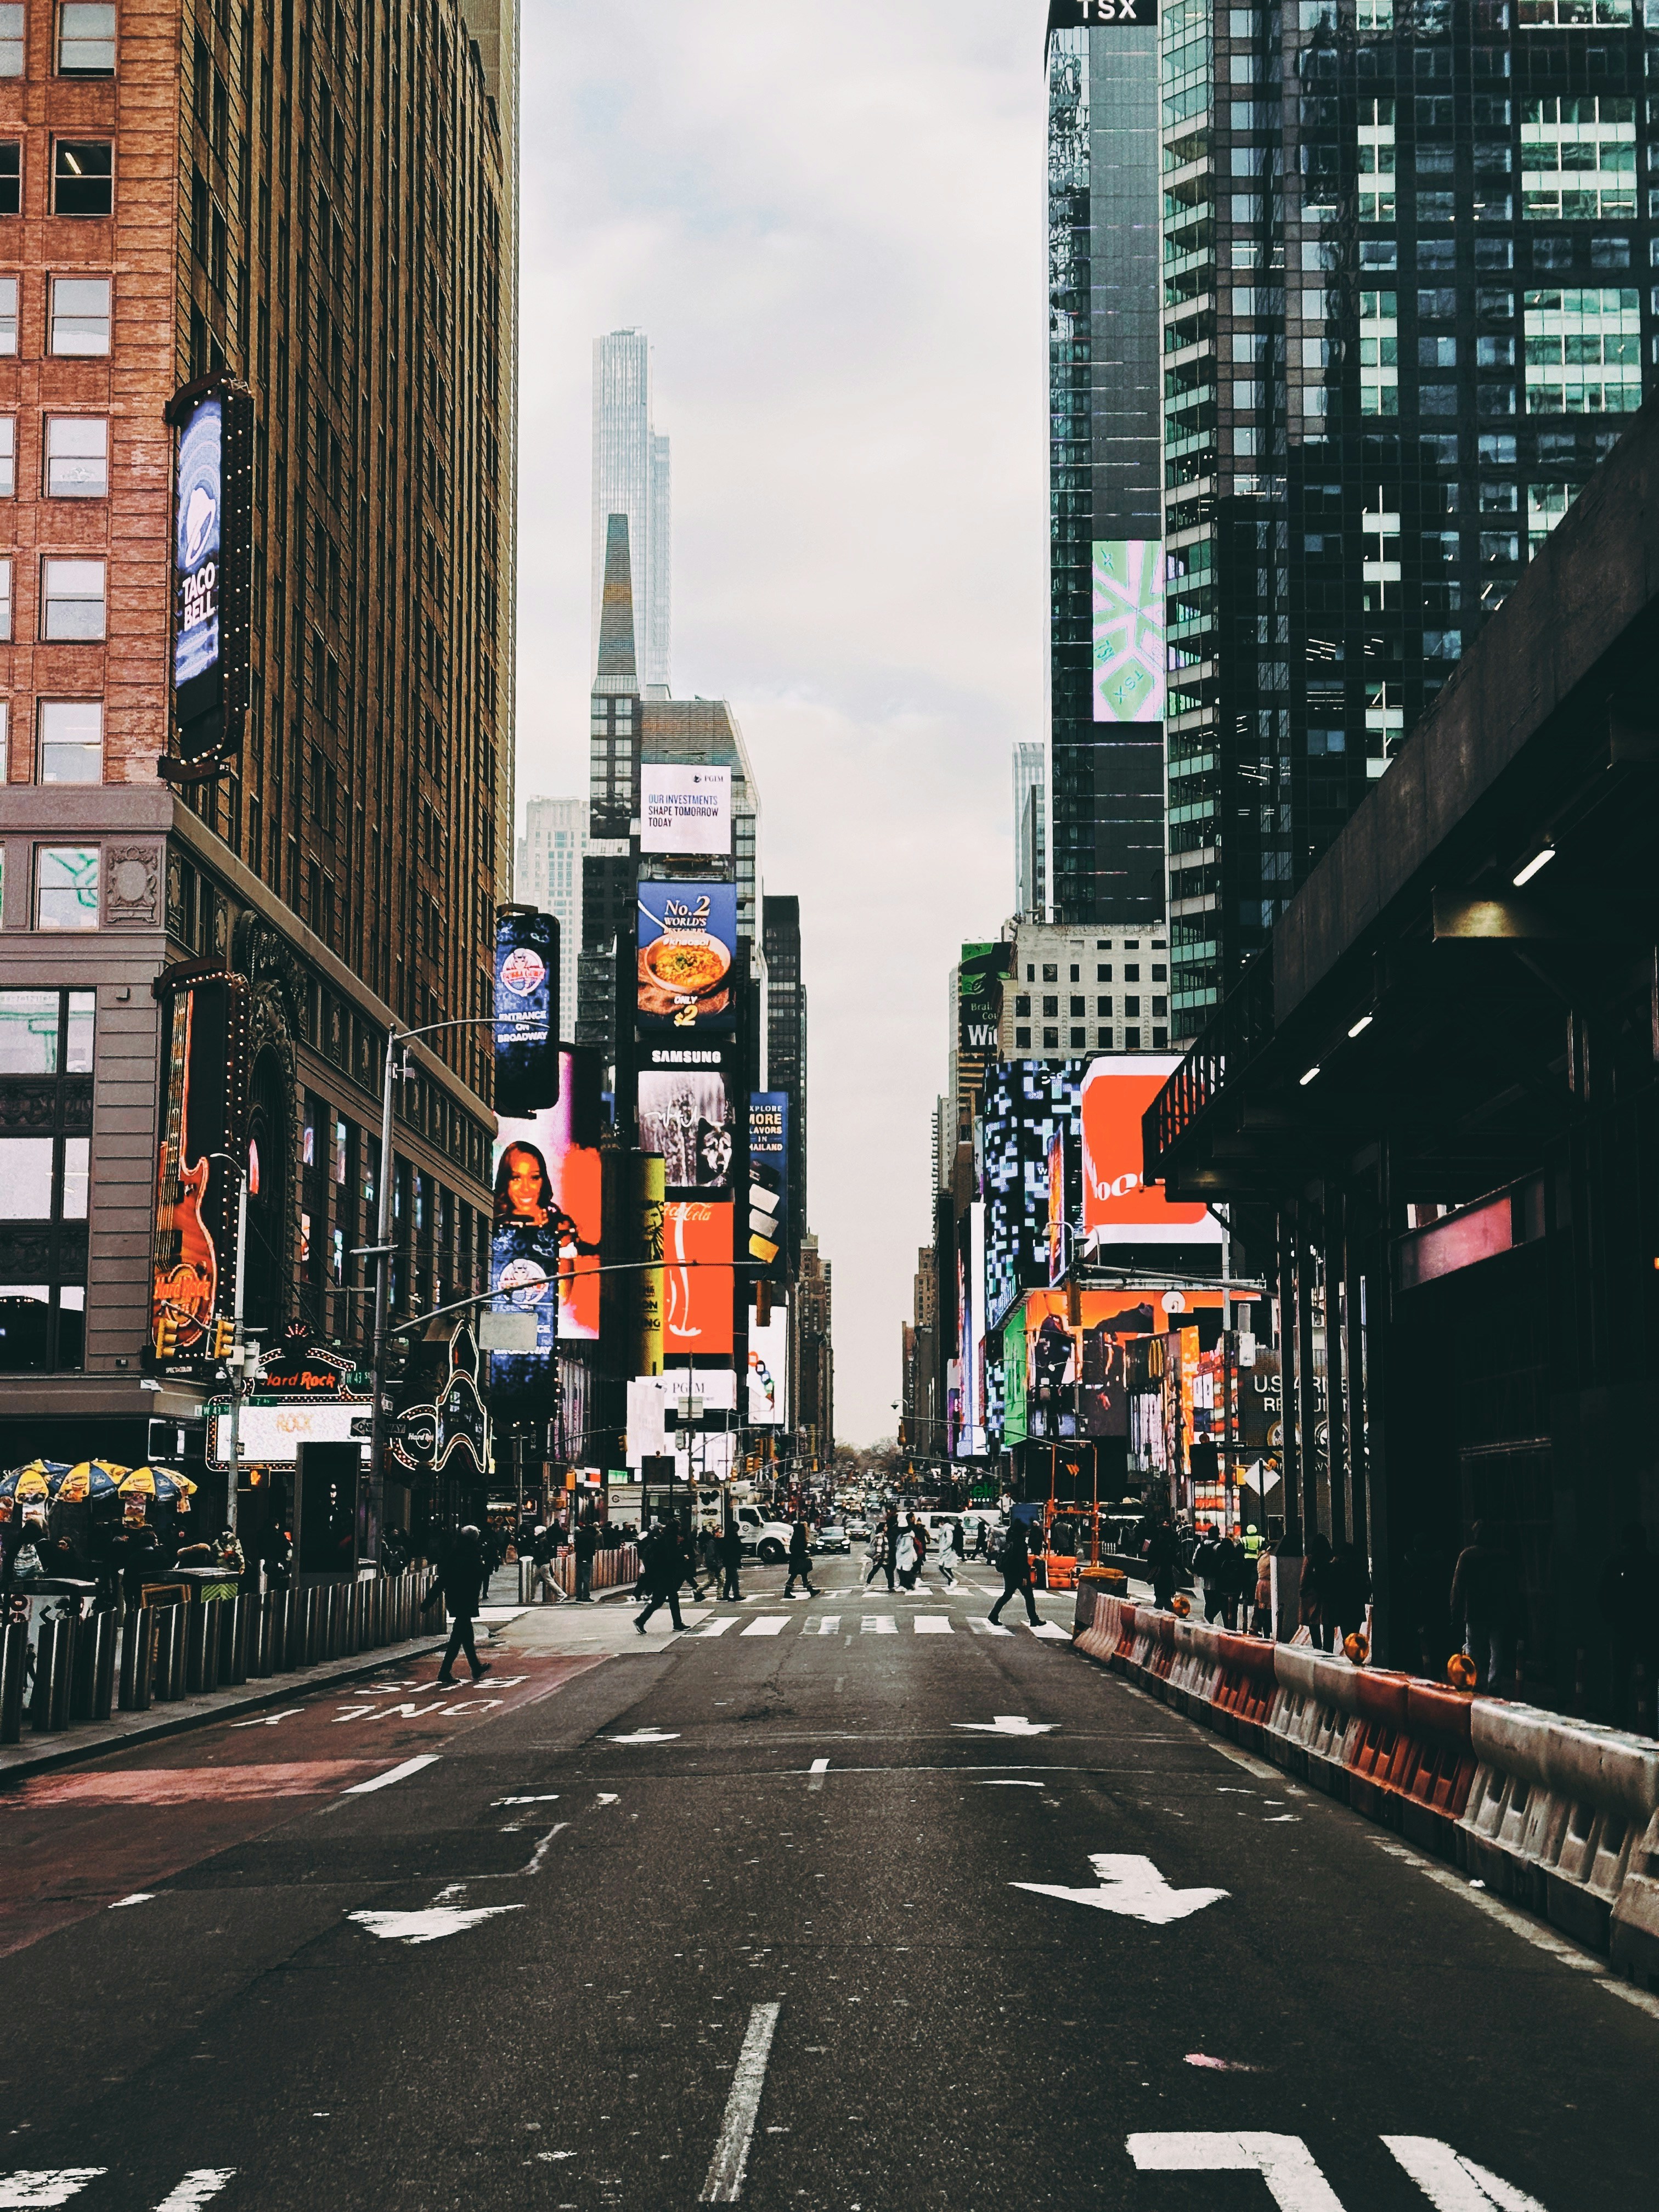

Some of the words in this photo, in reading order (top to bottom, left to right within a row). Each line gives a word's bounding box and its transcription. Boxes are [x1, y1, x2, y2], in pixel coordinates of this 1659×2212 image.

[1077, 0, 1137, 20] TSX
[182, 562, 216, 605] TACO
[184, 591, 216, 631] BELL
[648, 794, 664, 804] OUR
[665, 794, 718, 805] INVESTMENTS
[648, 806, 672, 816] SHAPE
[674, 806, 719, 816] TOMORROW
[648, 817, 673, 827] TODAY
[674, 996, 698, 1005] ONLY
[970, 1001, 992, 1011] Brai
[498, 1010, 546, 1020] ENTRANCE
[674, 1005, 698, 1026] $2
[497, 1031, 548, 1043] BROADWAY
[652, 1050, 721, 1063] SAMSUNG
[300, 1372, 336, 1390] Rock
[354, 1372, 362, 1384] 43
[1254, 1375, 1283, 1393] U.S
[673, 1383, 705, 1393] PGM
[212, 1406, 221, 1415] 43
[354, 1675, 531, 1695] BUS
